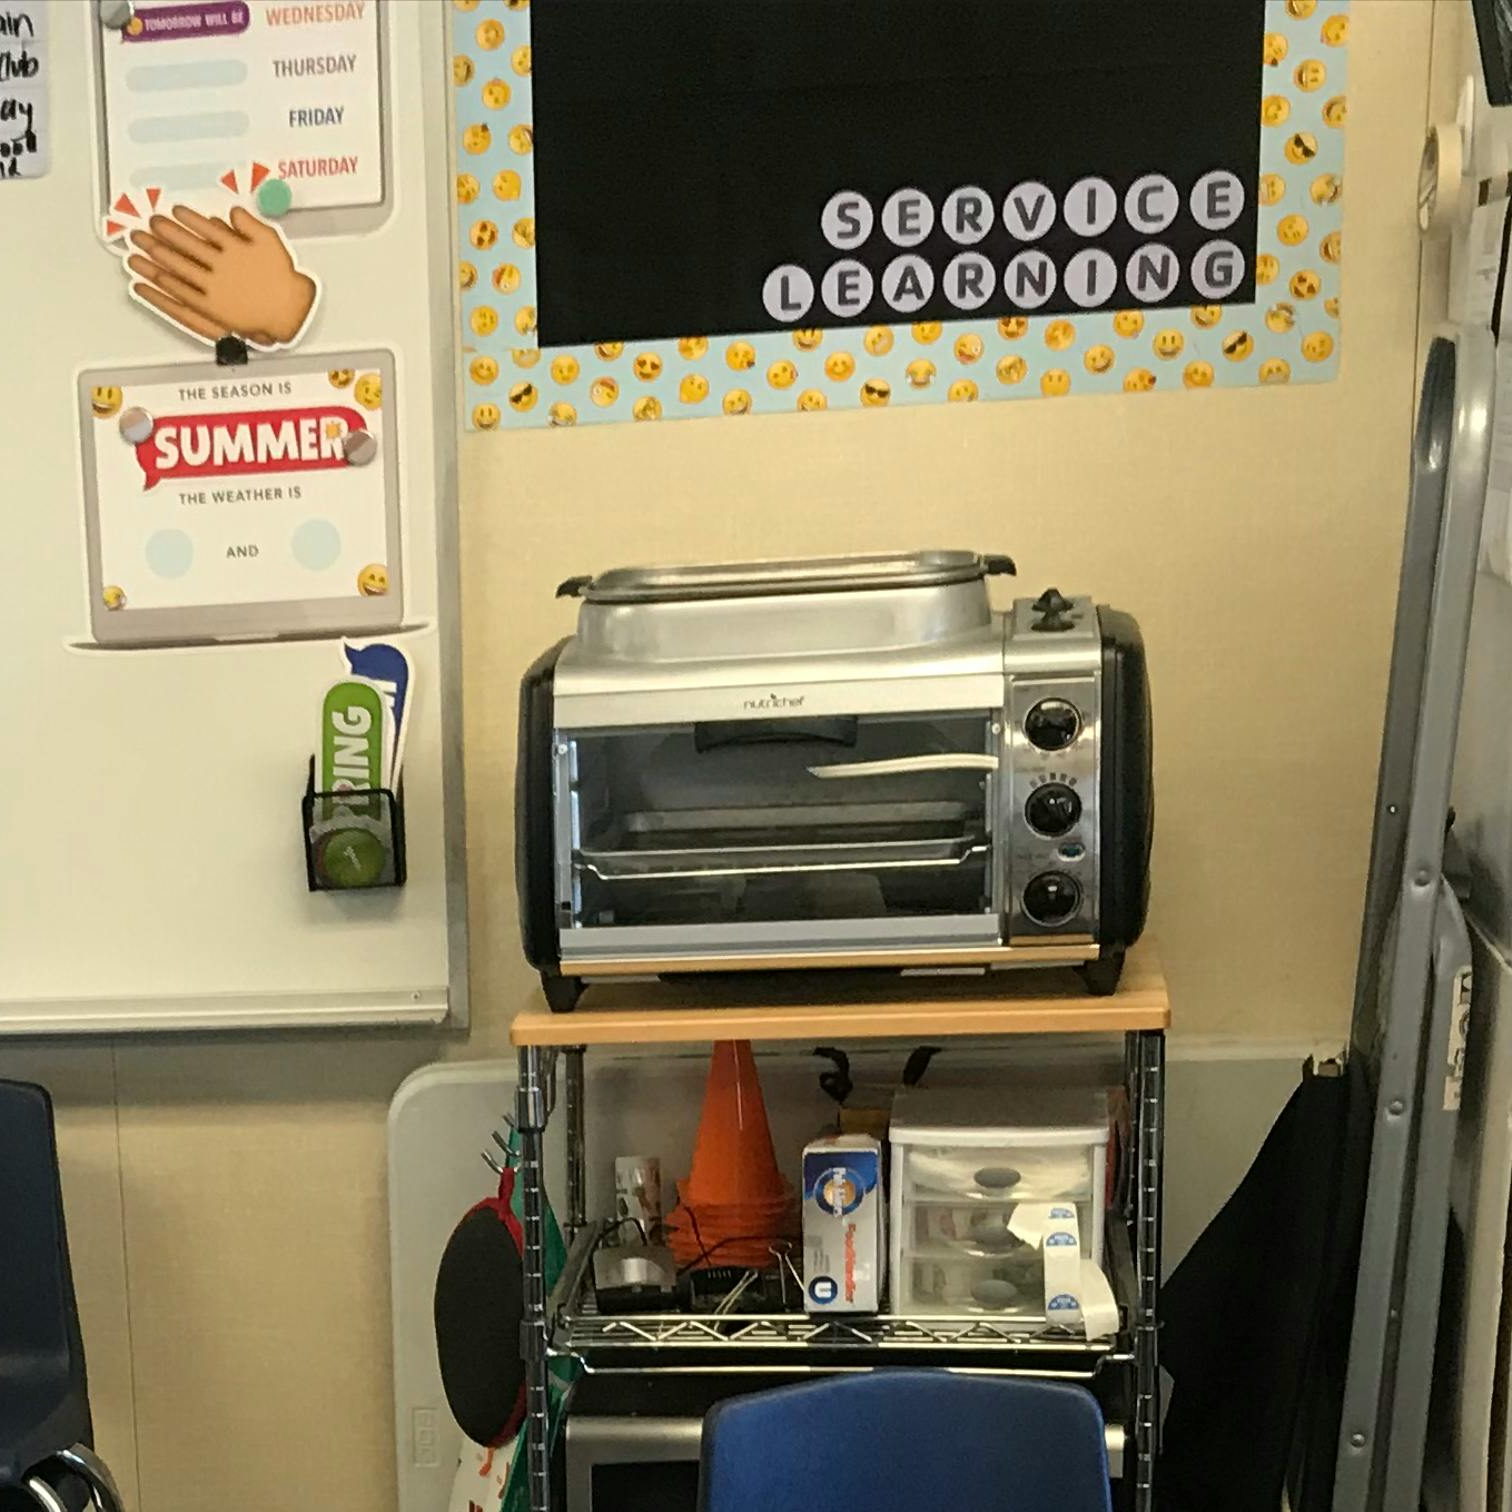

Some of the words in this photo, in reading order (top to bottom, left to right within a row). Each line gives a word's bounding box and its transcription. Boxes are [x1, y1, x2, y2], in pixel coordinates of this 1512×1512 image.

[144, 15, 202, 32] TOMORROW
[205, 13, 228, 27] WILL
[265, 2, 366, 26] WEDNESDAY
[272, 55, 357, 77] THURSDAY
[288, 107, 345, 128] FRIDAY
[277, 156, 359, 179] SATURDAY
[834, 178, 1234, 240] SERVICE
[778, 248, 1236, 314] LEARNING
[179, 388, 206, 401] THE
[212, 383, 273, 399] SEASON
[279, 382, 292, 394] IS
[155, 416, 349, 470] SUMMER
[179, 492, 206, 505] THE
[212, 487, 283, 504] WEATHER
[288, 486, 302, 498] IS
[226, 544, 259, 558] AND
